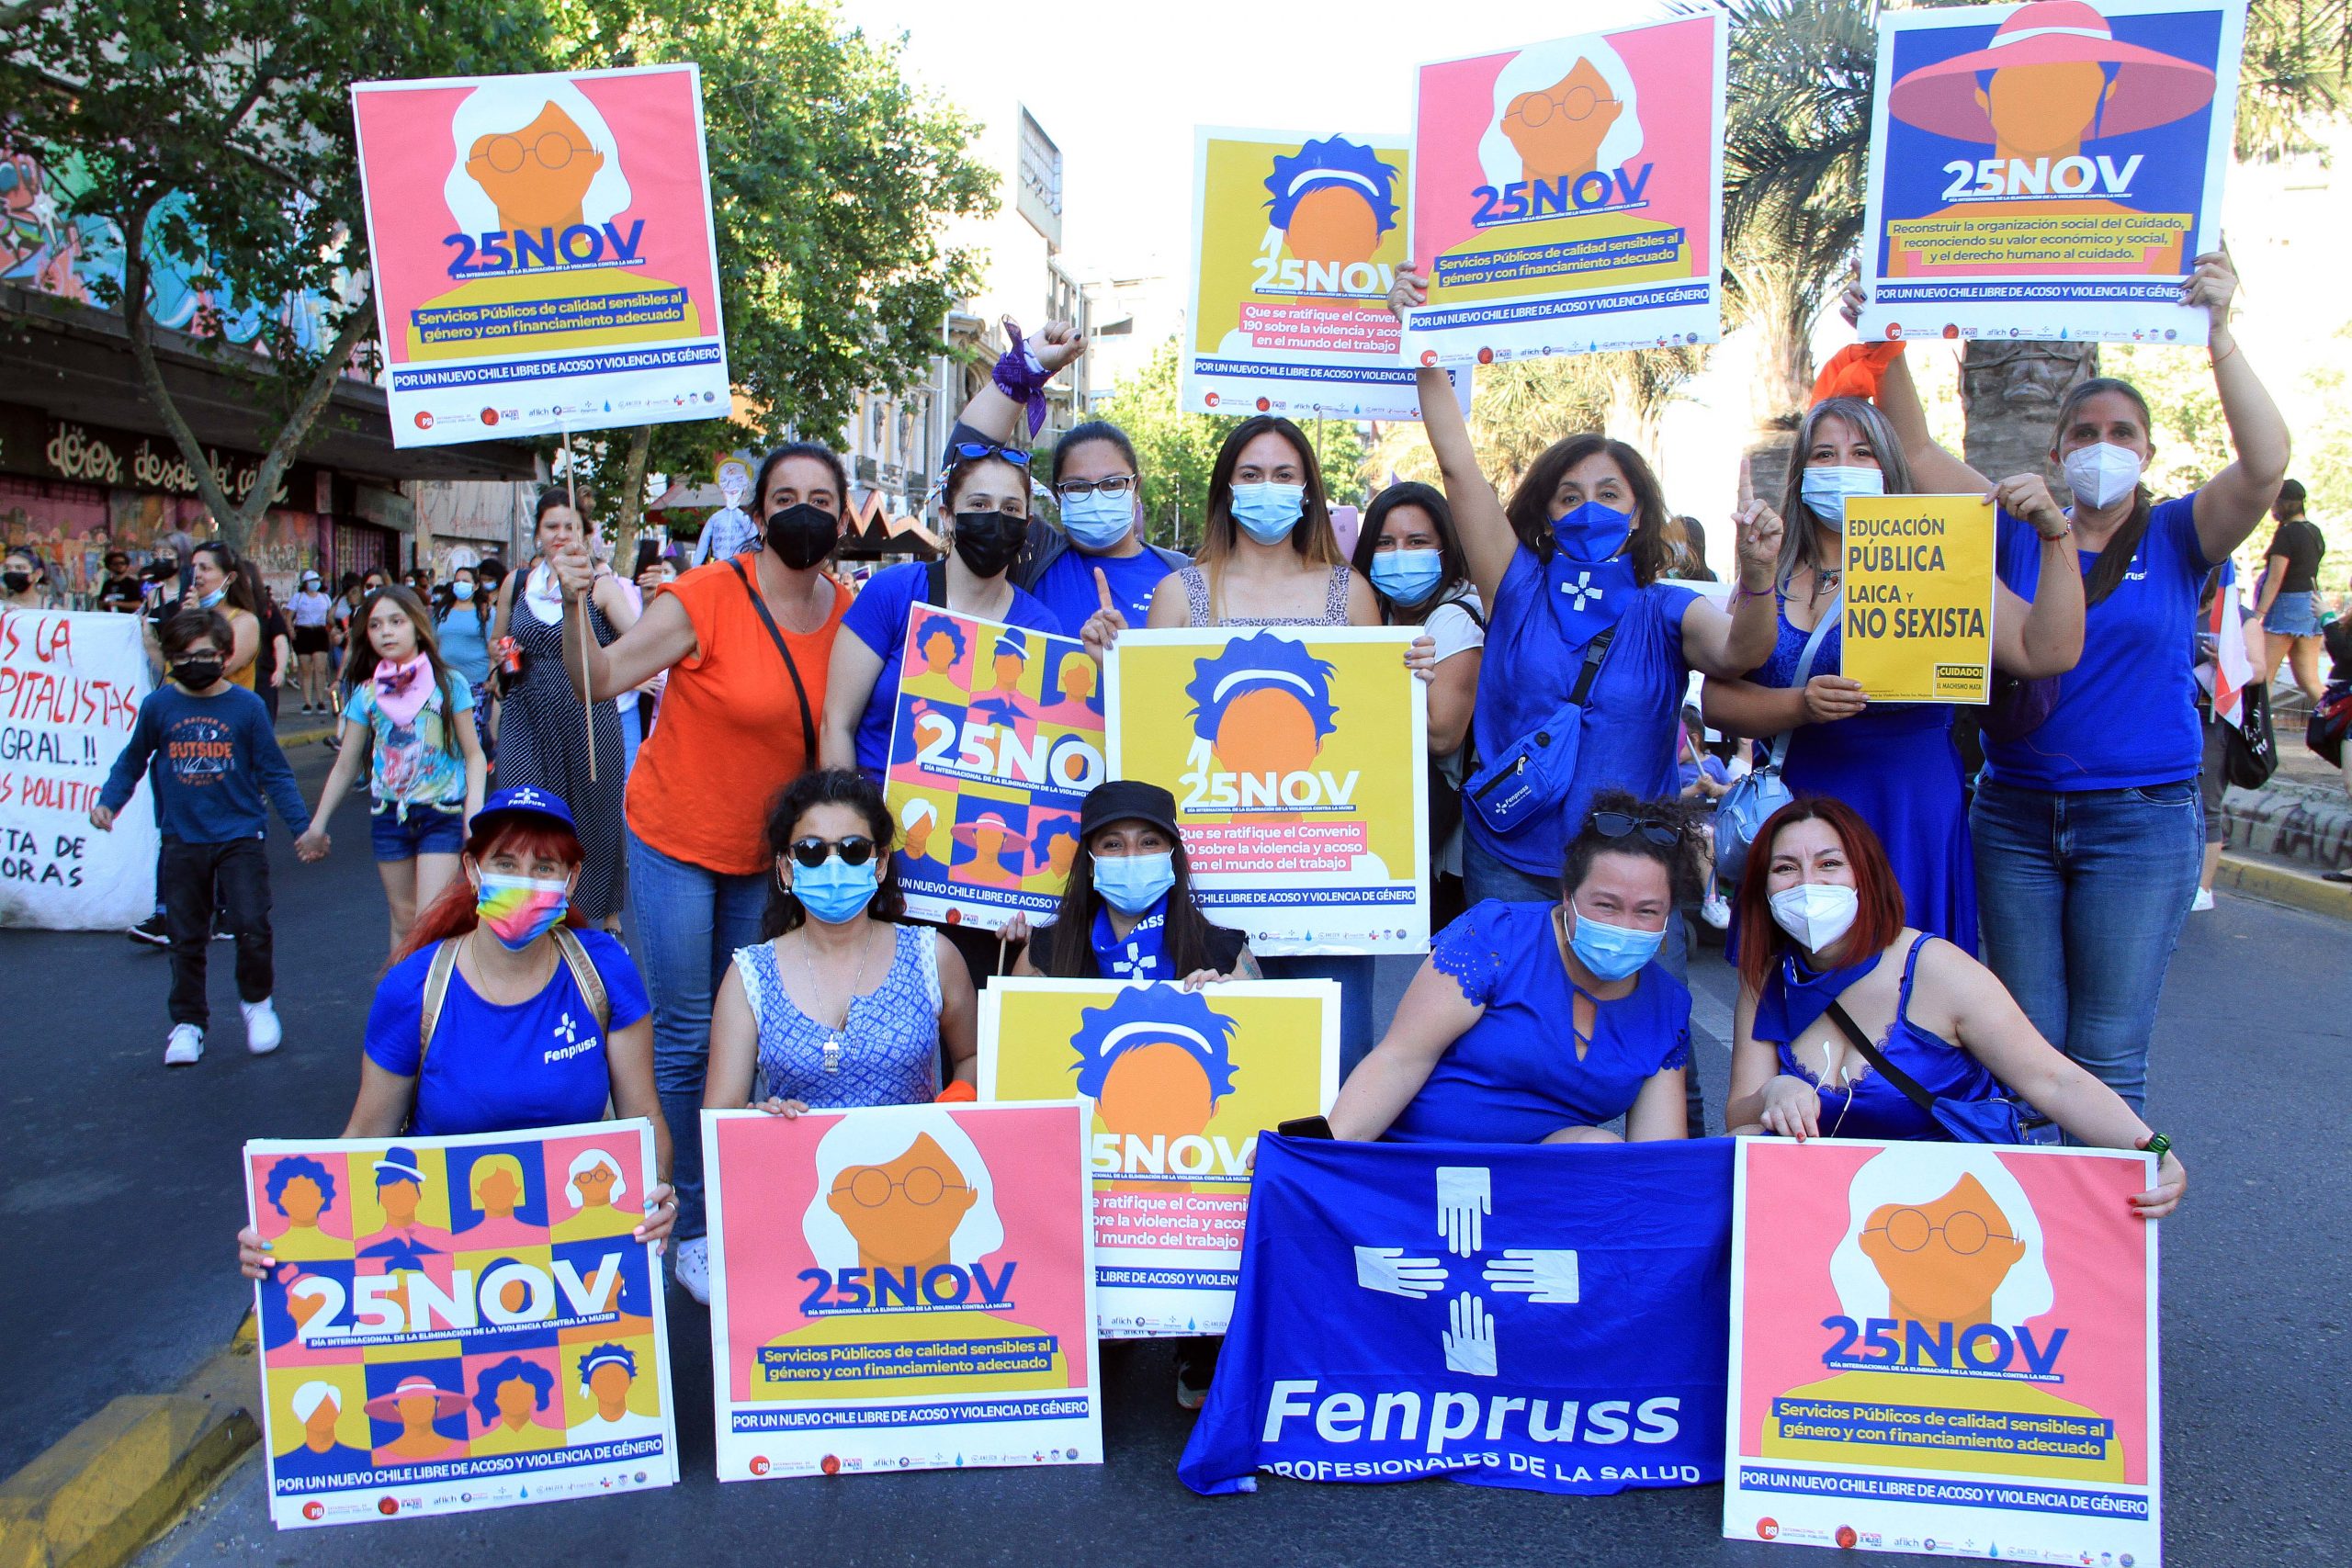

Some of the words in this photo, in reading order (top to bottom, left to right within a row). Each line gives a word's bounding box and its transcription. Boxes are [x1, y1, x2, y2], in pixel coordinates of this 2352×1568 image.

[1941, 154, 2144, 201] 25NOV
[1470, 163, 1654, 225] 25NOV
[1893, 223, 1962, 233] Reconstruir
[1963, 221, 1973, 231] la
[1977, 221, 2057, 232] organización
[2061, 219, 2098, 229] social
[2101, 218, 2121, 228] del
[2124, 217, 2184, 229] Cuidado,
[1904, 235, 1986, 247] reconociendo
[2007, 234, 2037, 244] valor
[2040, 232, 2112, 243] económico
[2115, 236, 2124, 245] y
[2127, 232, 2167, 244] social,
[443, 220, 645, 277] 25NOV
[1929, 254, 1938, 263] y
[1939, 251, 1950, 260] el
[1952, 250, 2003, 260] derecho
[2007, 249, 2061, 258] humano
[2064, 248, 2075, 258] al
[2077, 248, 2134, 258] cuidado.
[418, 309, 478, 324] Servicios
[481, 305, 537, 319] Públicos
[538, 302, 556, 314] de
[559, 298, 605, 312] calidad
[608, 294, 668, 309] sensibles
[671, 291, 681, 303] al
[1408, 315, 1431, 328] POR
[1432, 315, 1446, 325] UN
[1447, 311, 1480, 323] NUEVO
[1481, 309, 1510, 321] CHILE
[1510, 306, 1537, 318] LIBRE
[1538, 304, 1552, 315] DE
[1553, 300, 1587, 313] ACOSO
[1588, 299, 1595, 310] Y
[1596, 294, 1649, 309] VIOLENCIA
[1651, 292, 1665, 303] DE
[1666, 285, 1709, 301] GÉNERO
[424, 327, 472, 342] género
[474, 326, 482, 338] y
[485, 324, 510, 334] con
[512, 314, 613, 332] financiamiento
[616, 308, 680, 323] adecuado
[1257, 336, 1272, 344] en
[1274, 336, 1284, 345] el
[1287, 337, 1330, 348] mundo
[1333, 338, 1351, 348] del
[1353, 340, 1395, 352] trabajo
[1849, 513, 1945, 536] EDUCACIÓN
[1849, 538, 1945, 571] PÚBLICA
[1848, 585, 1902, 603] LAICA
[1906, 592, 1914, 603] Y
[1848, 607, 1887, 638] NO
[1894, 607, 1985, 638] SEXISTA
[37, 617, 73, 667] LA
[1937, 667, 1983, 678] ¡CUIDADO!
[169, 741, 232, 759] OUTSIDE
[916, 714, 1105, 790] 25NO
[22, 775, 102, 814] POLITIC
[1179, 770, 1360, 810] 25NOV
[1505, 784, 1529, 805] Fenpruss
[0, 829, 38, 855] TA
[56, 834, 87, 859] DE
[1198, 843, 1235, 854] sobre
[1238, 842, 1249, 853] la
[1251, 840, 1310, 853] violencia
[1313, 843, 1321, 855] y
[1324, 843, 1362, 852] acoso
[1206, 829, 1221, 839] se
[1225, 826, 1281, 840] ratifique
[1283, 826, 1295, 837] el
[1298, 825, 1360, 837] Convenio
[2, 857, 84, 888] ORAS
[1191, 861, 1207, 869] en
[1210, 858, 1222, 869] el
[1226, 858, 1273, 869] mundo
[1276, 857, 1296, 869] del
[1299, 855, 1346, 871] trabajo
[898, 877, 911, 888] UN
[912, 879, 946, 894] NUEVO
[947, 885, 975, 898] CHILE
[976, 889, 1003, 902] LIBRE
[1004, 893, 1017, 904] DE
[1019, 896, 1052, 908] ACOSO
[1054, 899, 1060, 908] Y
[544, 1036, 597, 1065] Fenpruss
[1091, 1134, 1258, 1177] 5NOV
[1102, 1232, 1156, 1245] mundo
[1159, 1233, 1182, 1246] del
[1185, 1233, 1238, 1249] trabajo
[291, 1252, 623, 1344] 25NOV
[796, 1261, 1018, 1314] 25NOV
[311, 1337, 326, 1347] DÍA
[328, 1334, 392, 1346] INTERNACIONAL
[419, 1328, 471, 1340] ELIMINACIÓN
[473, 1327, 484, 1336] DE
[498, 1322, 541, 1333] VIOLENCIA
[542, 1319, 575, 1328] CONTRA
[589, 1313, 615, 1322] MUJER
[1820, 1314, 2070, 1375] 25NOV
[1261, 1380, 1680, 1453] Fenpruss
[1780, 1403, 1849, 1419] Servicios
[1853, 1407, 1921, 1424] Públicos
[1924, 1412, 1945, 1426] de
[1948, 1414, 2007, 1429] calidad
[2010, 1418, 2086, 1435] sensibles
[2090, 1423, 2104, 1437] al
[1783, 1421, 1840, 1438] género
[1843, 1427, 1853, 1441] y
[1856, 1429, 1886, 1440] con
[1889, 1427, 2014, 1449] financiamiento
[2017, 1438, 2100, 1455] adecuado
[1510, 1453, 1545, 1476] DE
[1555, 1463, 1593, 1483] LA
[1600, 1466, 1701, 1483] SALUD
